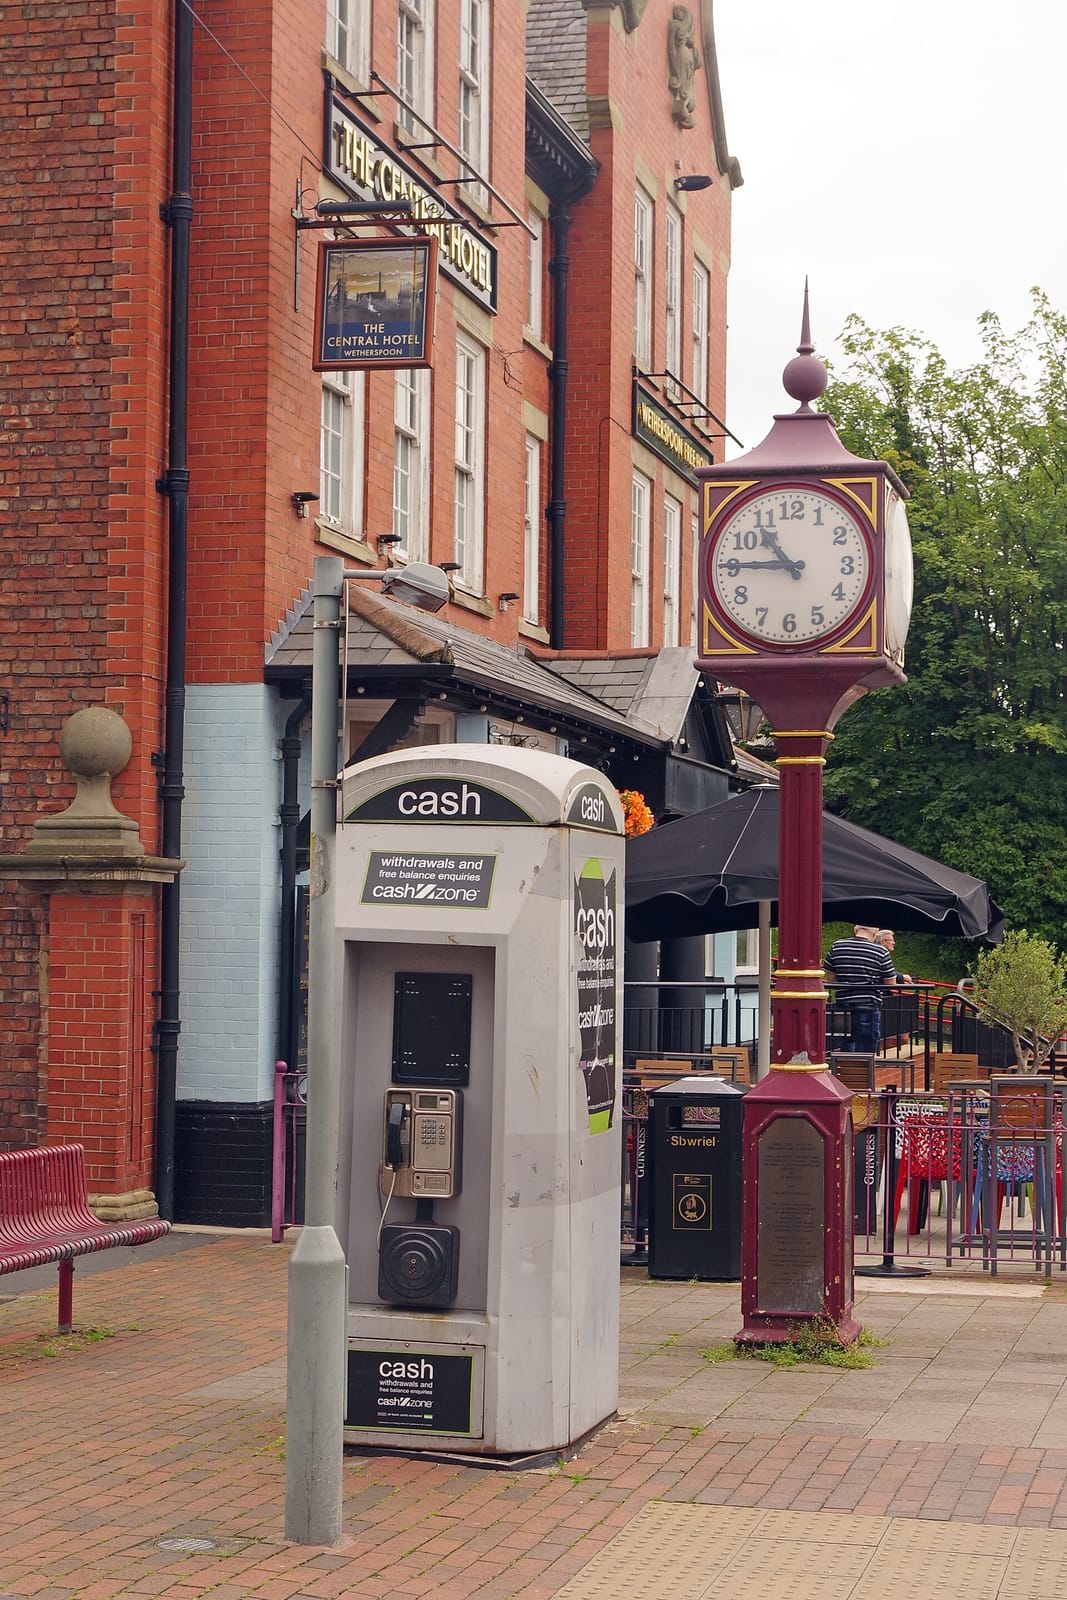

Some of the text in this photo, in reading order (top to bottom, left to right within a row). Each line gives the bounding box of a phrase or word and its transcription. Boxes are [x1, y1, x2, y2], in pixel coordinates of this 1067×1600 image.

[341, 120, 375, 187] THE
[452, 222, 492, 292] HOTEL
[363, 323, 385, 334] THE
[327, 334, 420, 347] CENTRAL HOTEL
[344, 348, 403, 357] WETHERSPOON
[640, 402, 684, 457] WETHERSPOON
[754, 508, 776, 528] 11
[779, 500, 805, 520] 12
[813, 507, 824, 526] 1
[733, 531, 757, 550] 10
[833, 526, 847, 546] 2
[727, 558, 740, 577] 9
[840, 555, 854, 575] 3
[734, 585, 748, 605] 8
[831, 581, 845, 601] 4
[755, 607, 768, 626] 7
[782, 613, 797, 633] 6
[810, 606, 824, 625] 5
[398, 784, 481, 816] cash
[581, 792, 605, 823] cash
[381, 857, 483, 870] withdrawals and
[379, 870, 481, 882] free balance enquiries
[577, 896, 614, 949] cash
[606, 955, 614, 970] and
[671, 1135, 716, 1148] Sbwriel
[635, 1128, 645, 1178] GUINNESS
[864, 1134, 875, 1185] GUINNESS
[379, 1359, 433, 1379] cash
[379, 1379, 433, 1389] withdrawals and
